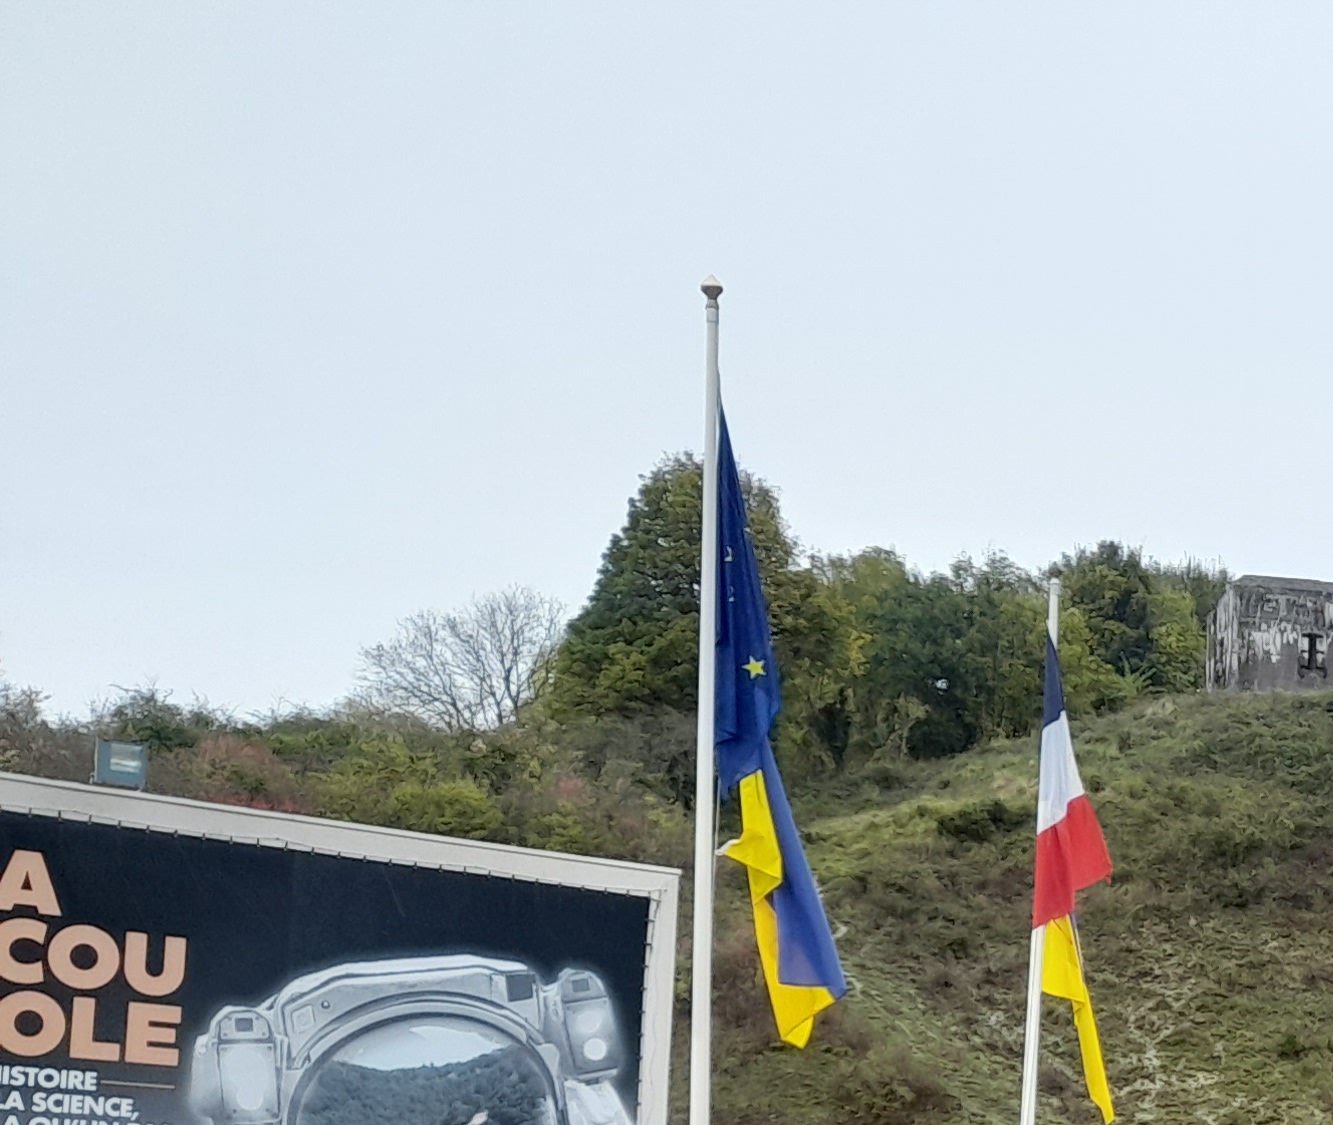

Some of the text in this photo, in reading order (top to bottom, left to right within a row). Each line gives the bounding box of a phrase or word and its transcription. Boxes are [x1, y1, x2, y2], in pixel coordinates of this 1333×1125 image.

[0, 849, 62, 917] A
[0, 917, 188, 997] COU
[0, 990, 183, 1067] OLE
[0, 1065, 98, 1091] ISTOIRE
[31, 1092, 139, 1121] SCIENCE,
